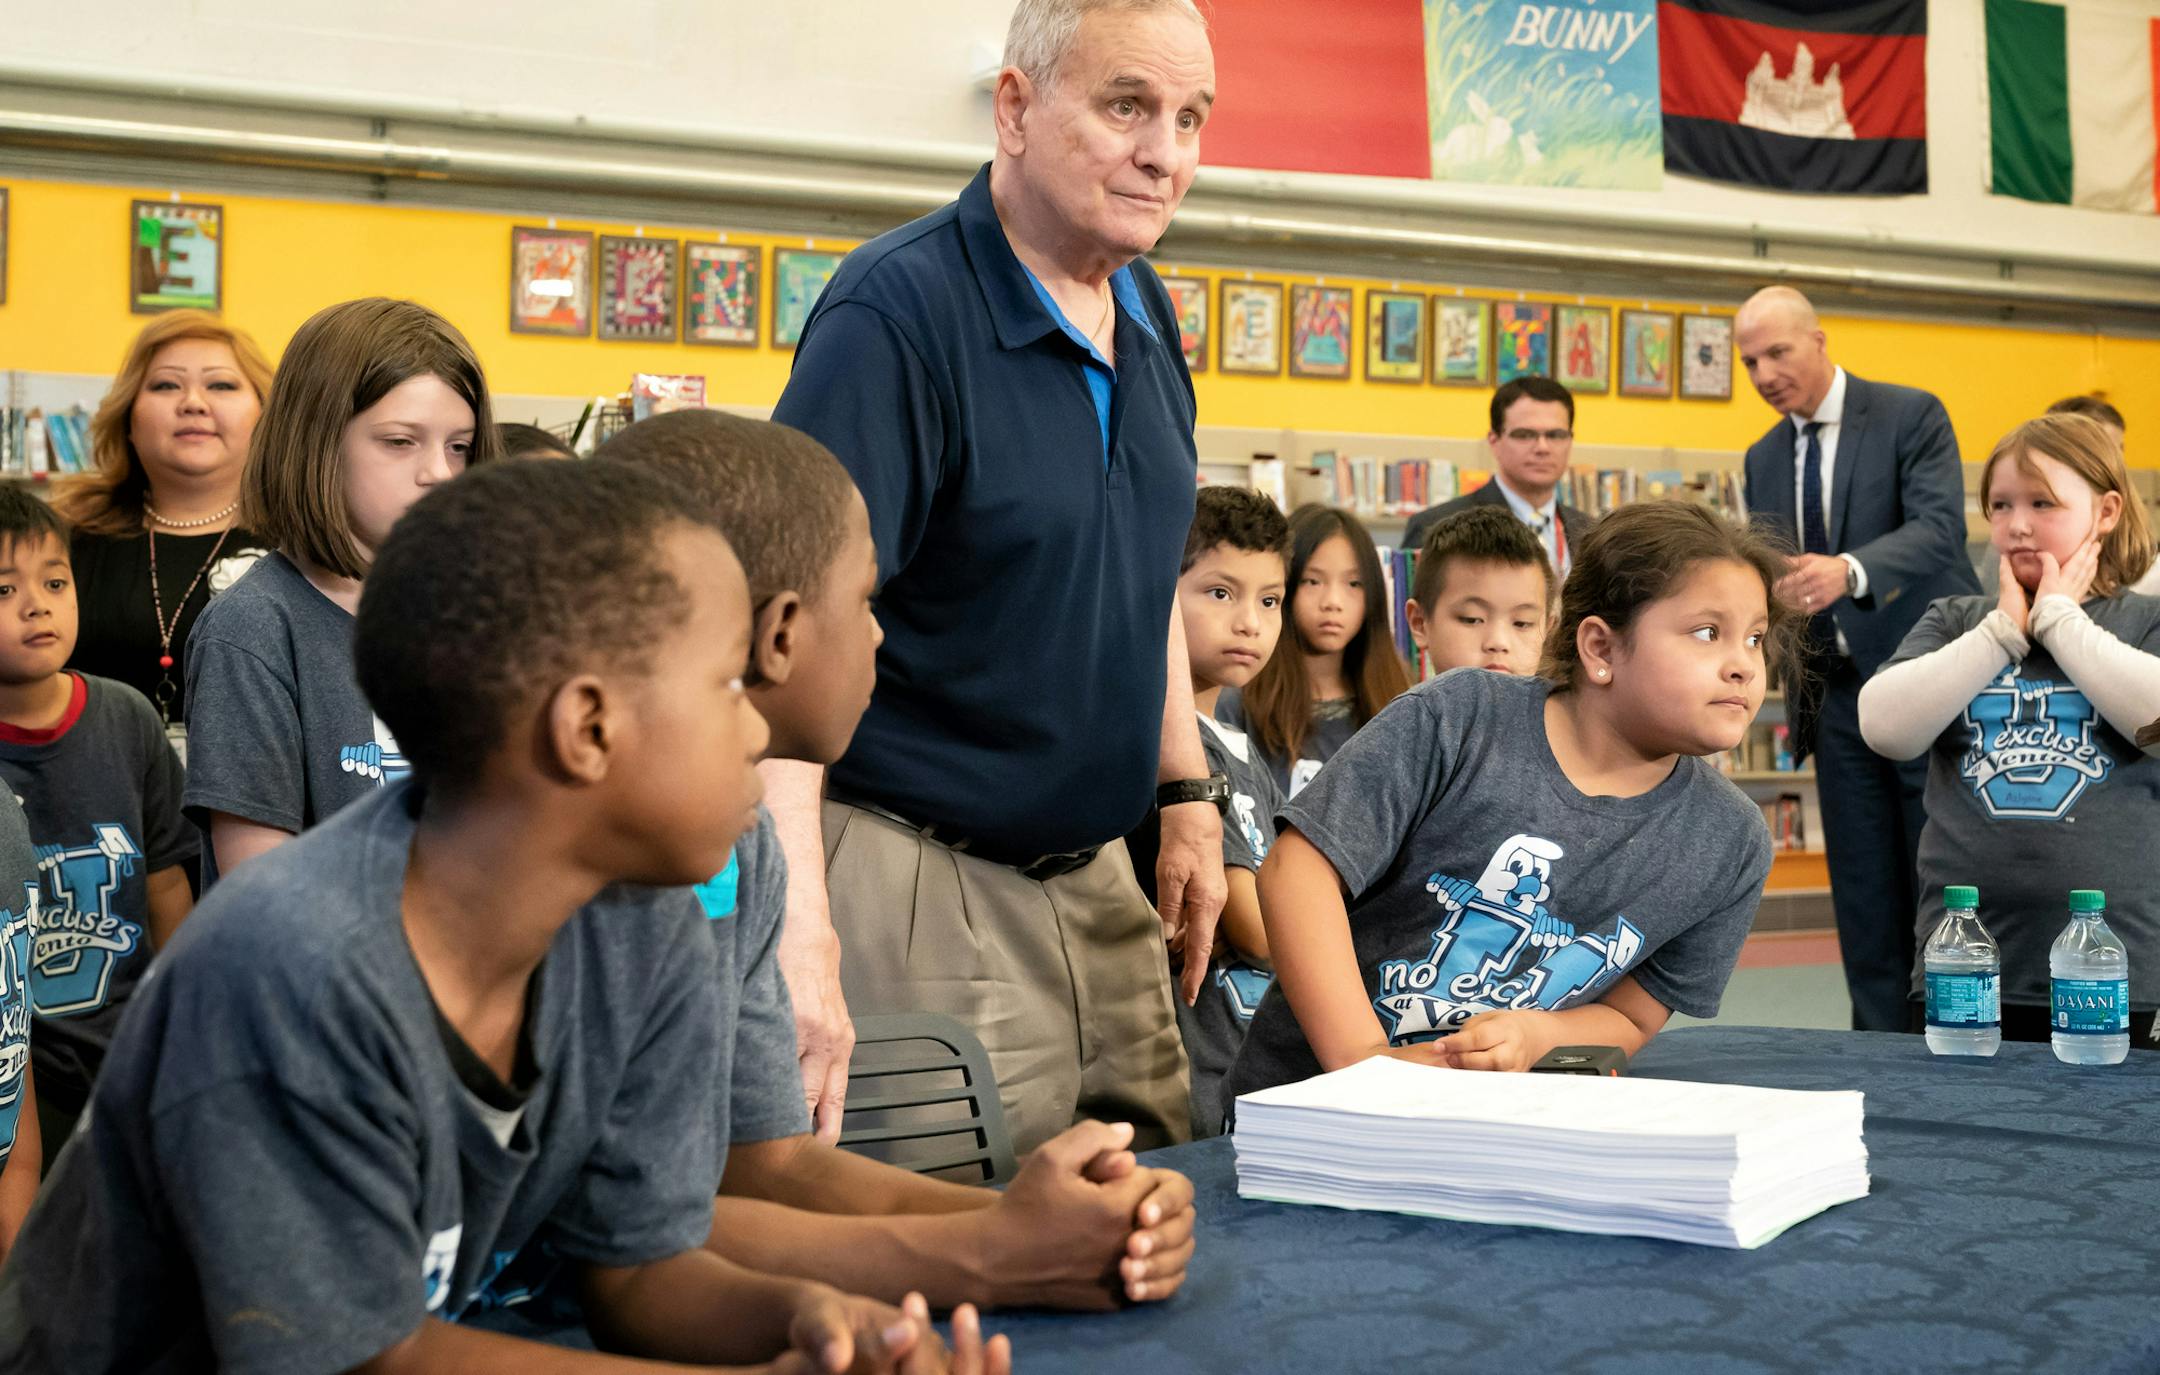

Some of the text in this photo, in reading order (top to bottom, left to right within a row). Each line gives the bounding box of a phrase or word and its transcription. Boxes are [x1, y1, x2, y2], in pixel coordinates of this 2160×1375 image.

[1504, 4, 1655, 65] BUNNY
[1985, 751, 2069, 772] Vento
[1993, 726, 2112, 777] excuses
[37, 904, 138, 951] xcuses
[36, 936, 92, 958] ento
[1384, 963, 1438, 990] no
[1394, 996, 1414, 1010] at
[2057, 991, 2114, 1011] DASANI
